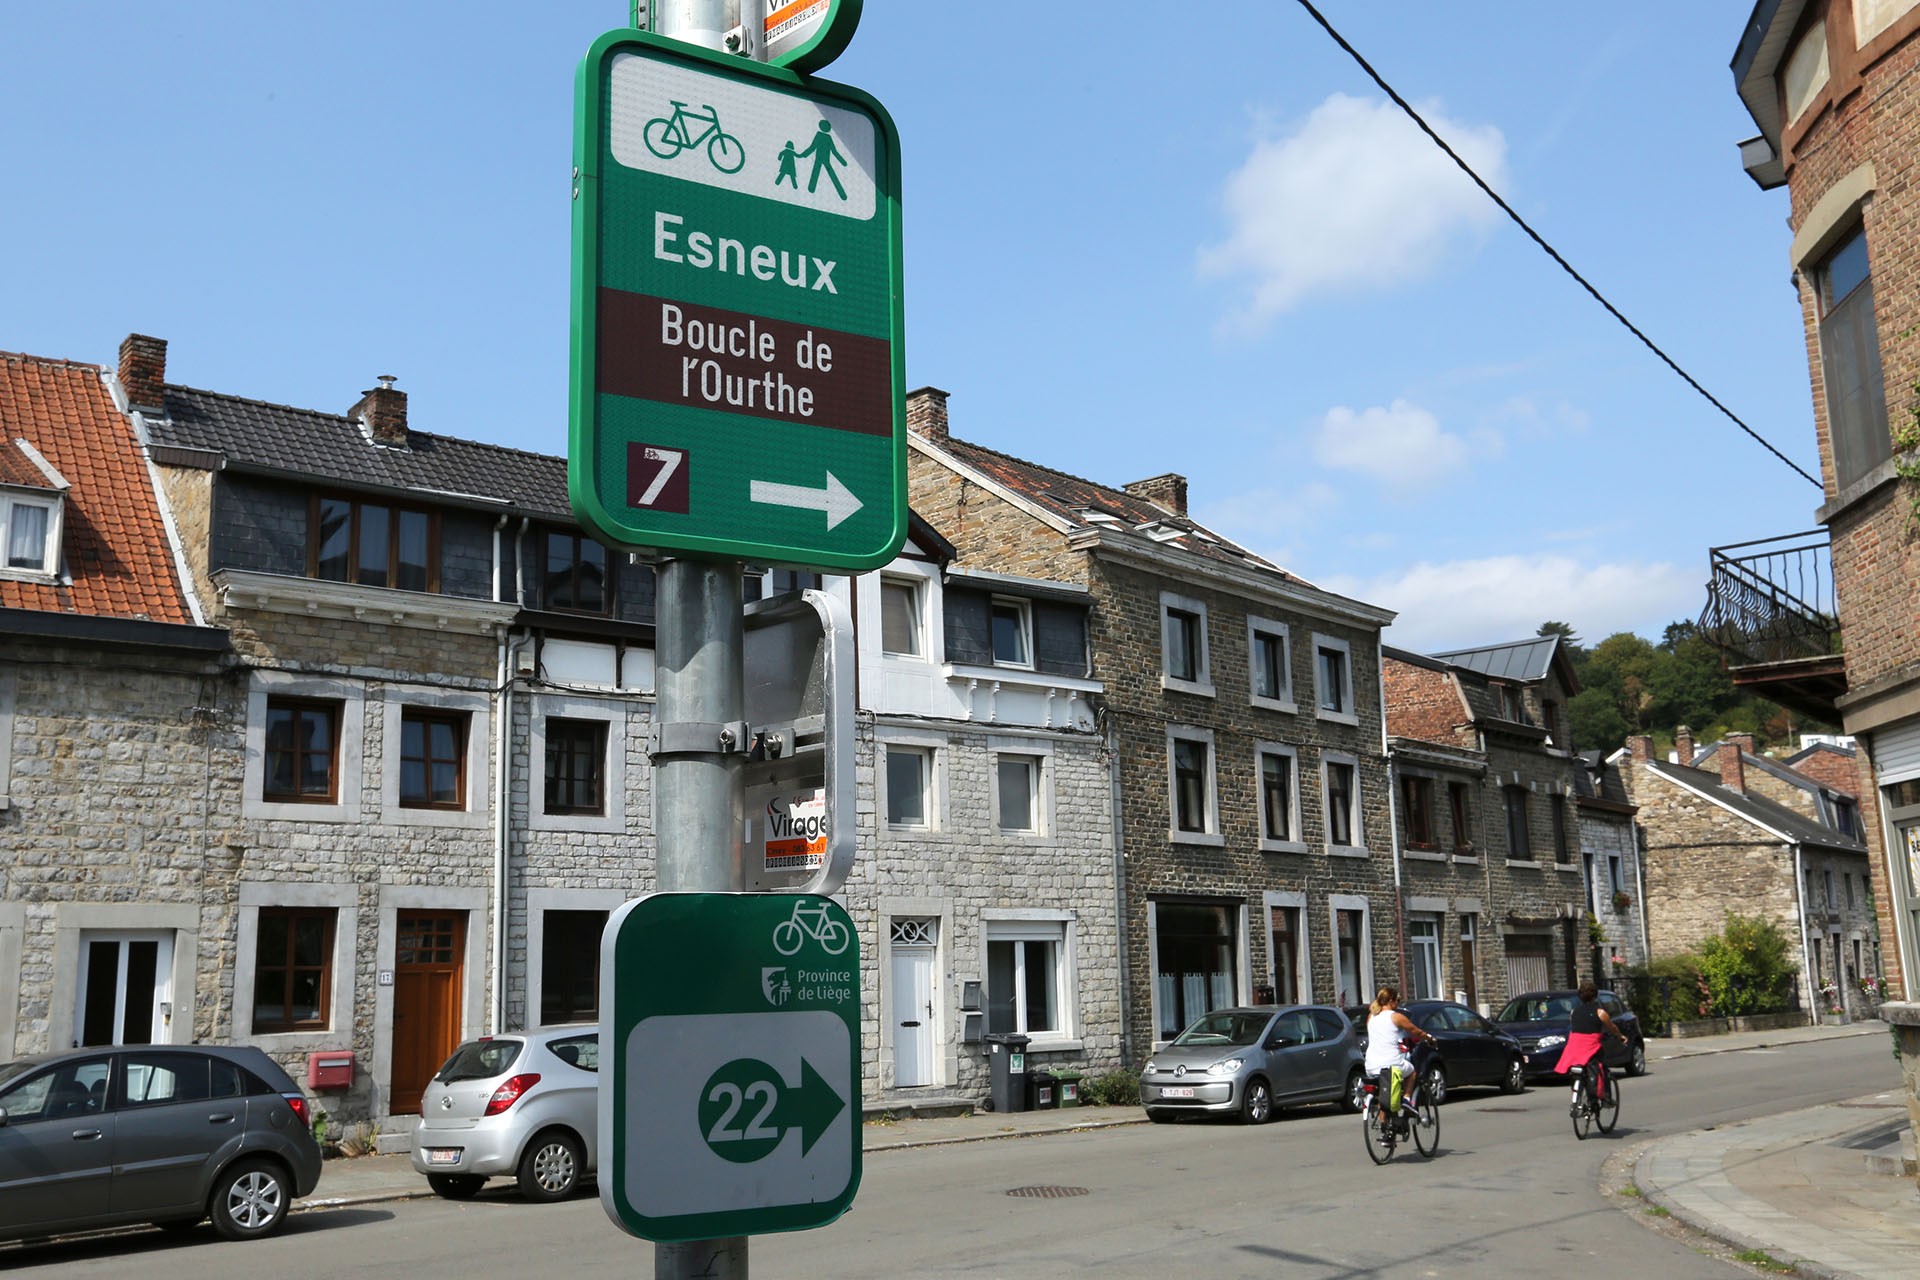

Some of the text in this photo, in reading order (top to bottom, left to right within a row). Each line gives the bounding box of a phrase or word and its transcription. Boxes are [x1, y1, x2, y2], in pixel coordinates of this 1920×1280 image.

[653, 210, 838, 295] Esneux
[661, 303, 834, 373] Boucle de
[682, 356, 814, 418] l'Ourthe
[638, 447, 683, 506] 7
[770, 814, 826, 841] Virage
[797, 969, 851, 983] Province
[797, 986, 851, 1005] de Liège
[707, 1080, 778, 1142] 22
